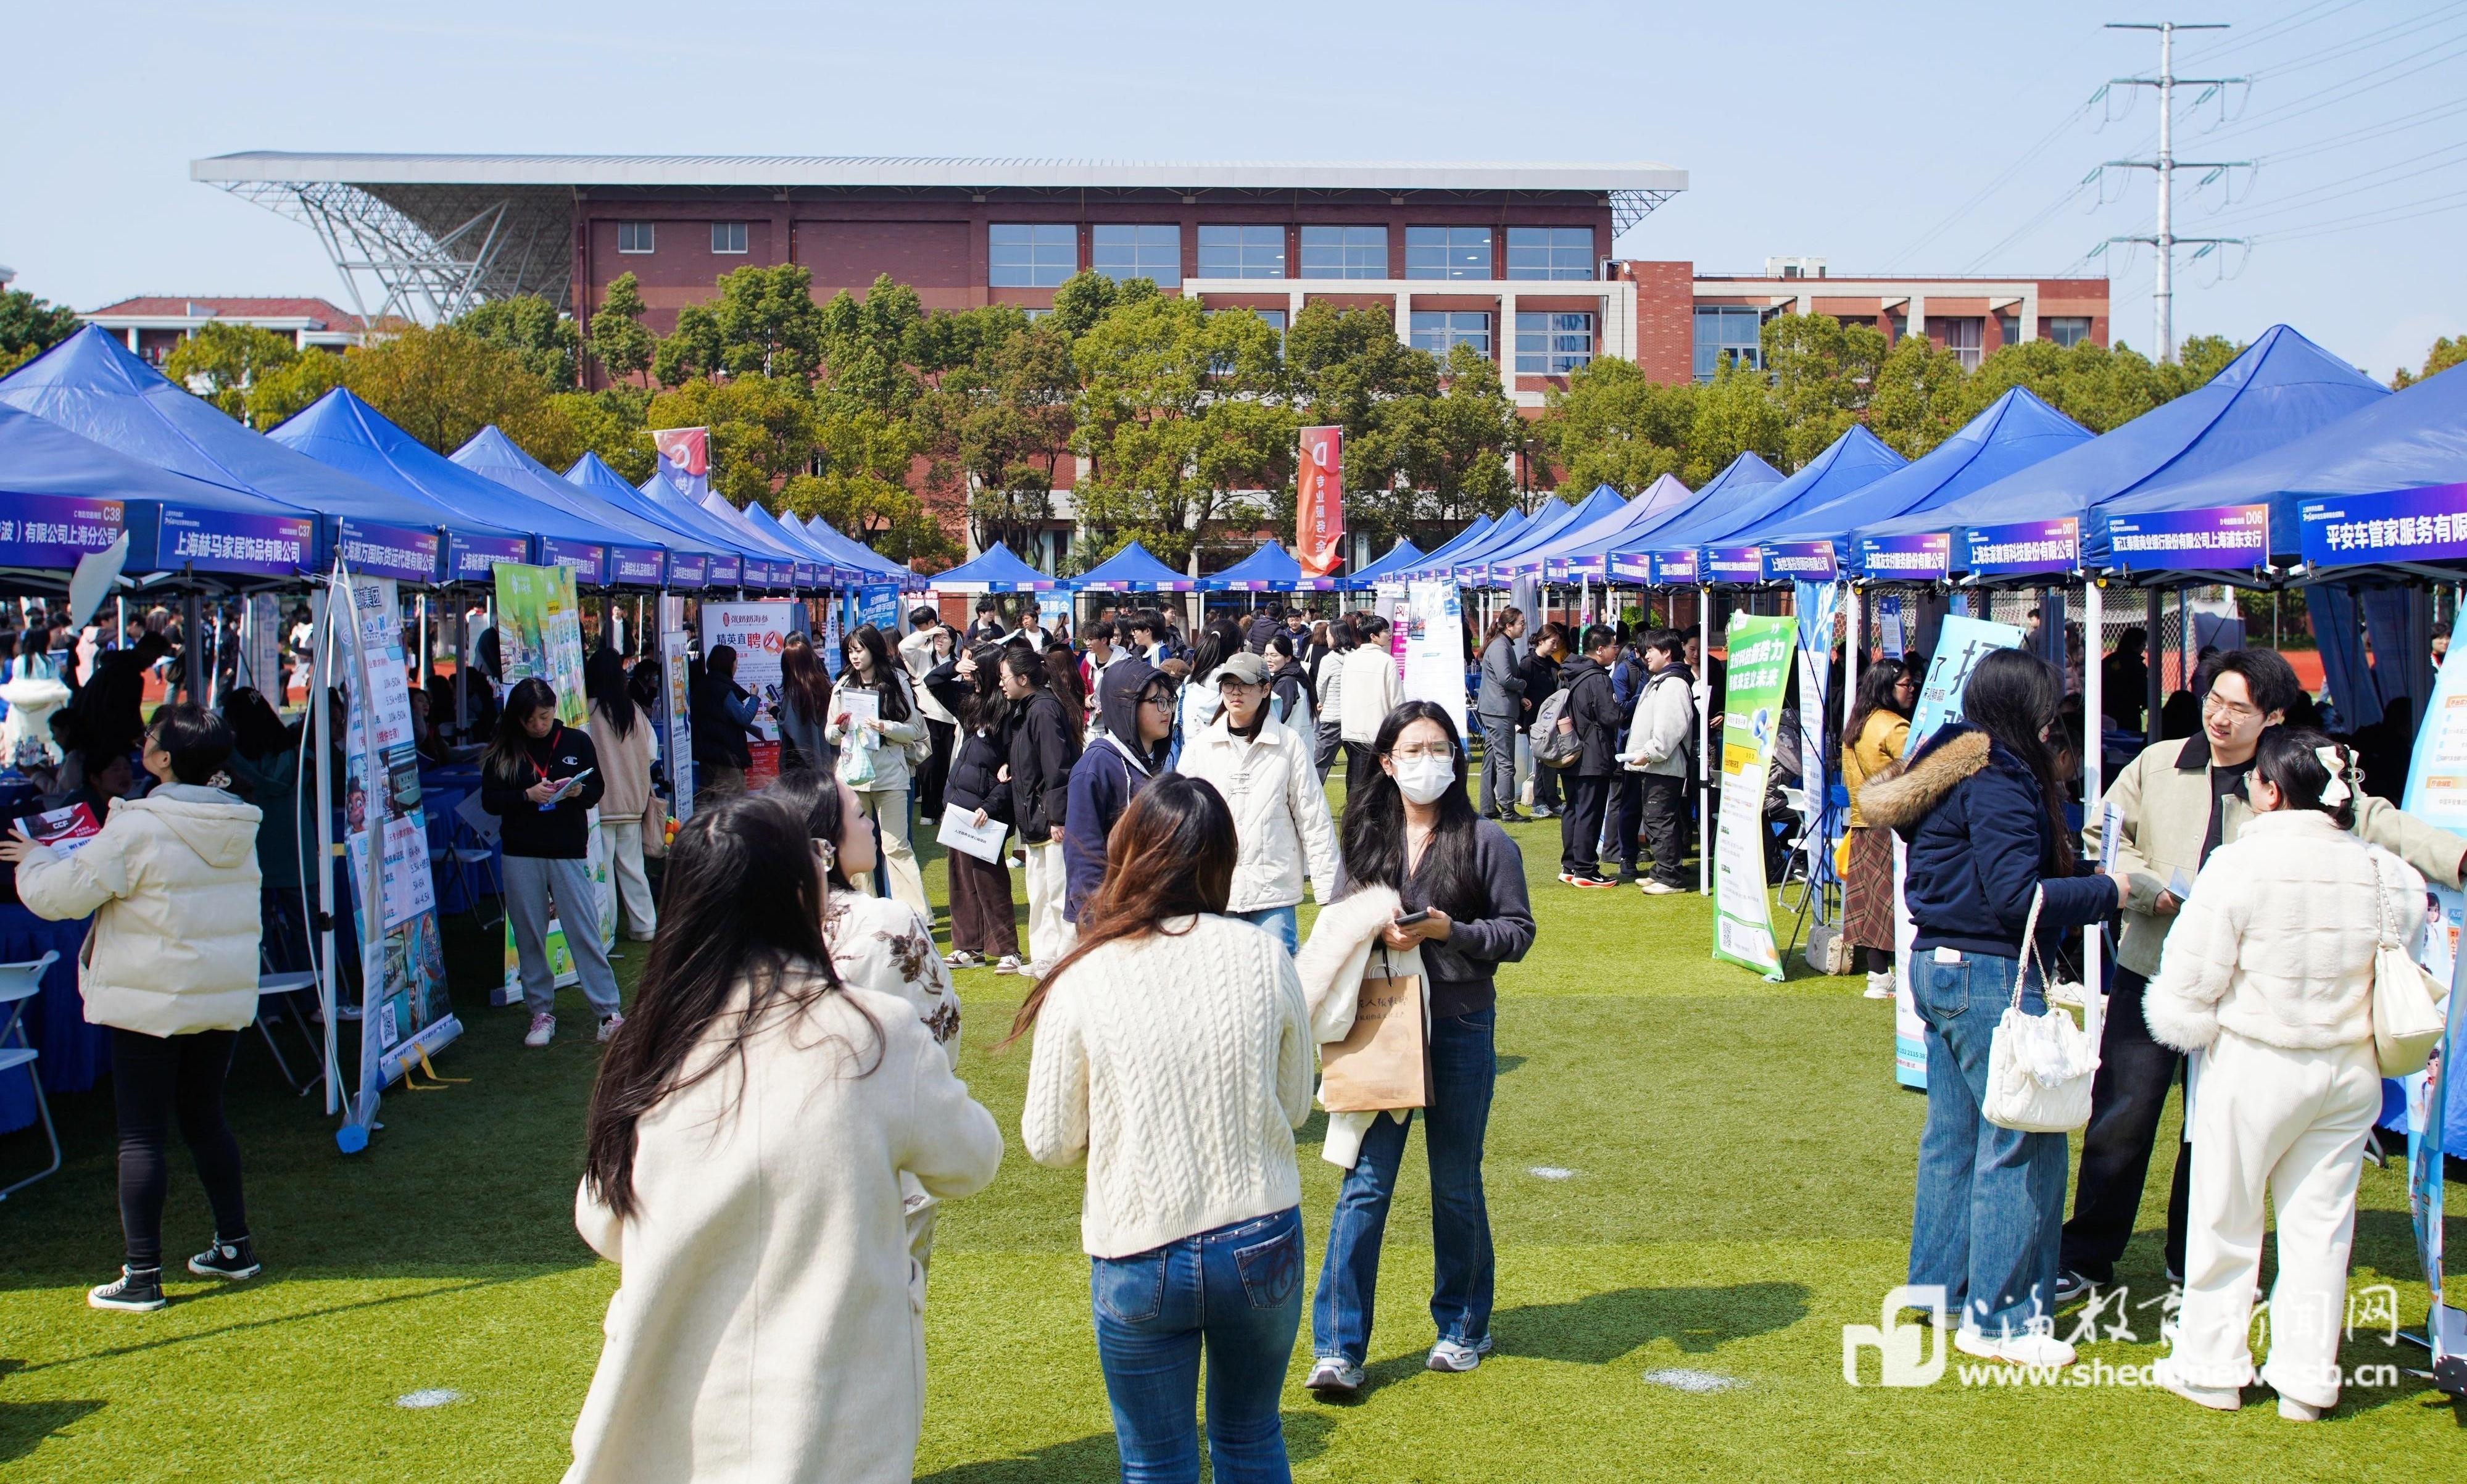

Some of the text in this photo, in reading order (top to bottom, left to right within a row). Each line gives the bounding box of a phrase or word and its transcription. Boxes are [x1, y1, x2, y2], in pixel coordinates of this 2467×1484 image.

[103, 507, 121, 522] C38
[2245, 511, 2263, 524] D06
[0, 520, 117, 547] 波）有限公司上海分公司
[299, 524, 310, 537] C37
[2063, 523, 2075, 535] D07
[716, 632, 761, 649] 精英直聘
[52, 820, 69, 830] CCF
